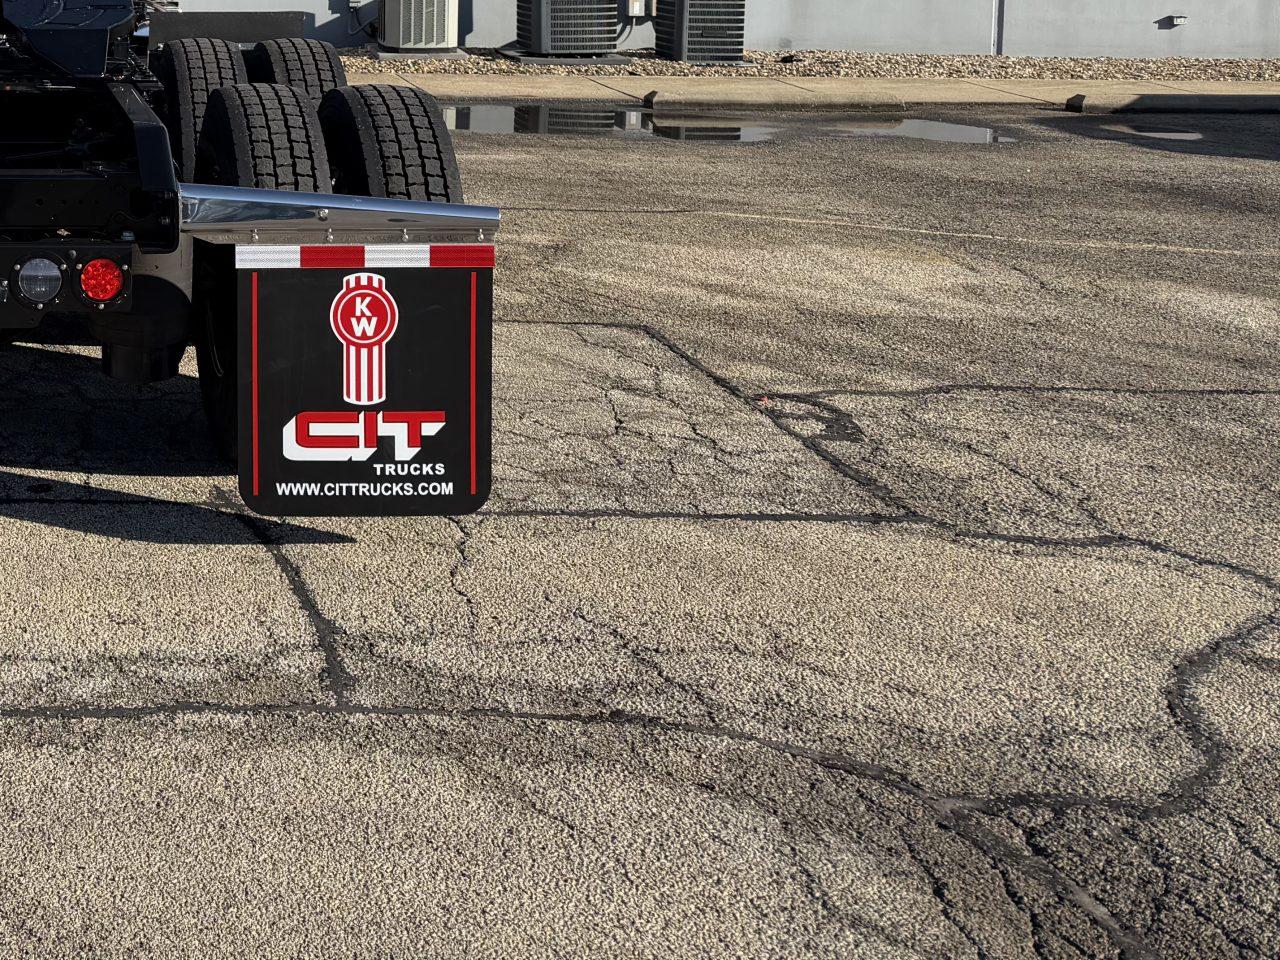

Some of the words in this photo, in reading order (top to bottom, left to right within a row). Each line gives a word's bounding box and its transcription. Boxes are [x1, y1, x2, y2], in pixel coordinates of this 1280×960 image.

[287, 410, 447, 456] CIT
[373, 463, 446, 476] TRUCKS
[276, 482, 454, 497] WWW.CITTRUCKS.COM
